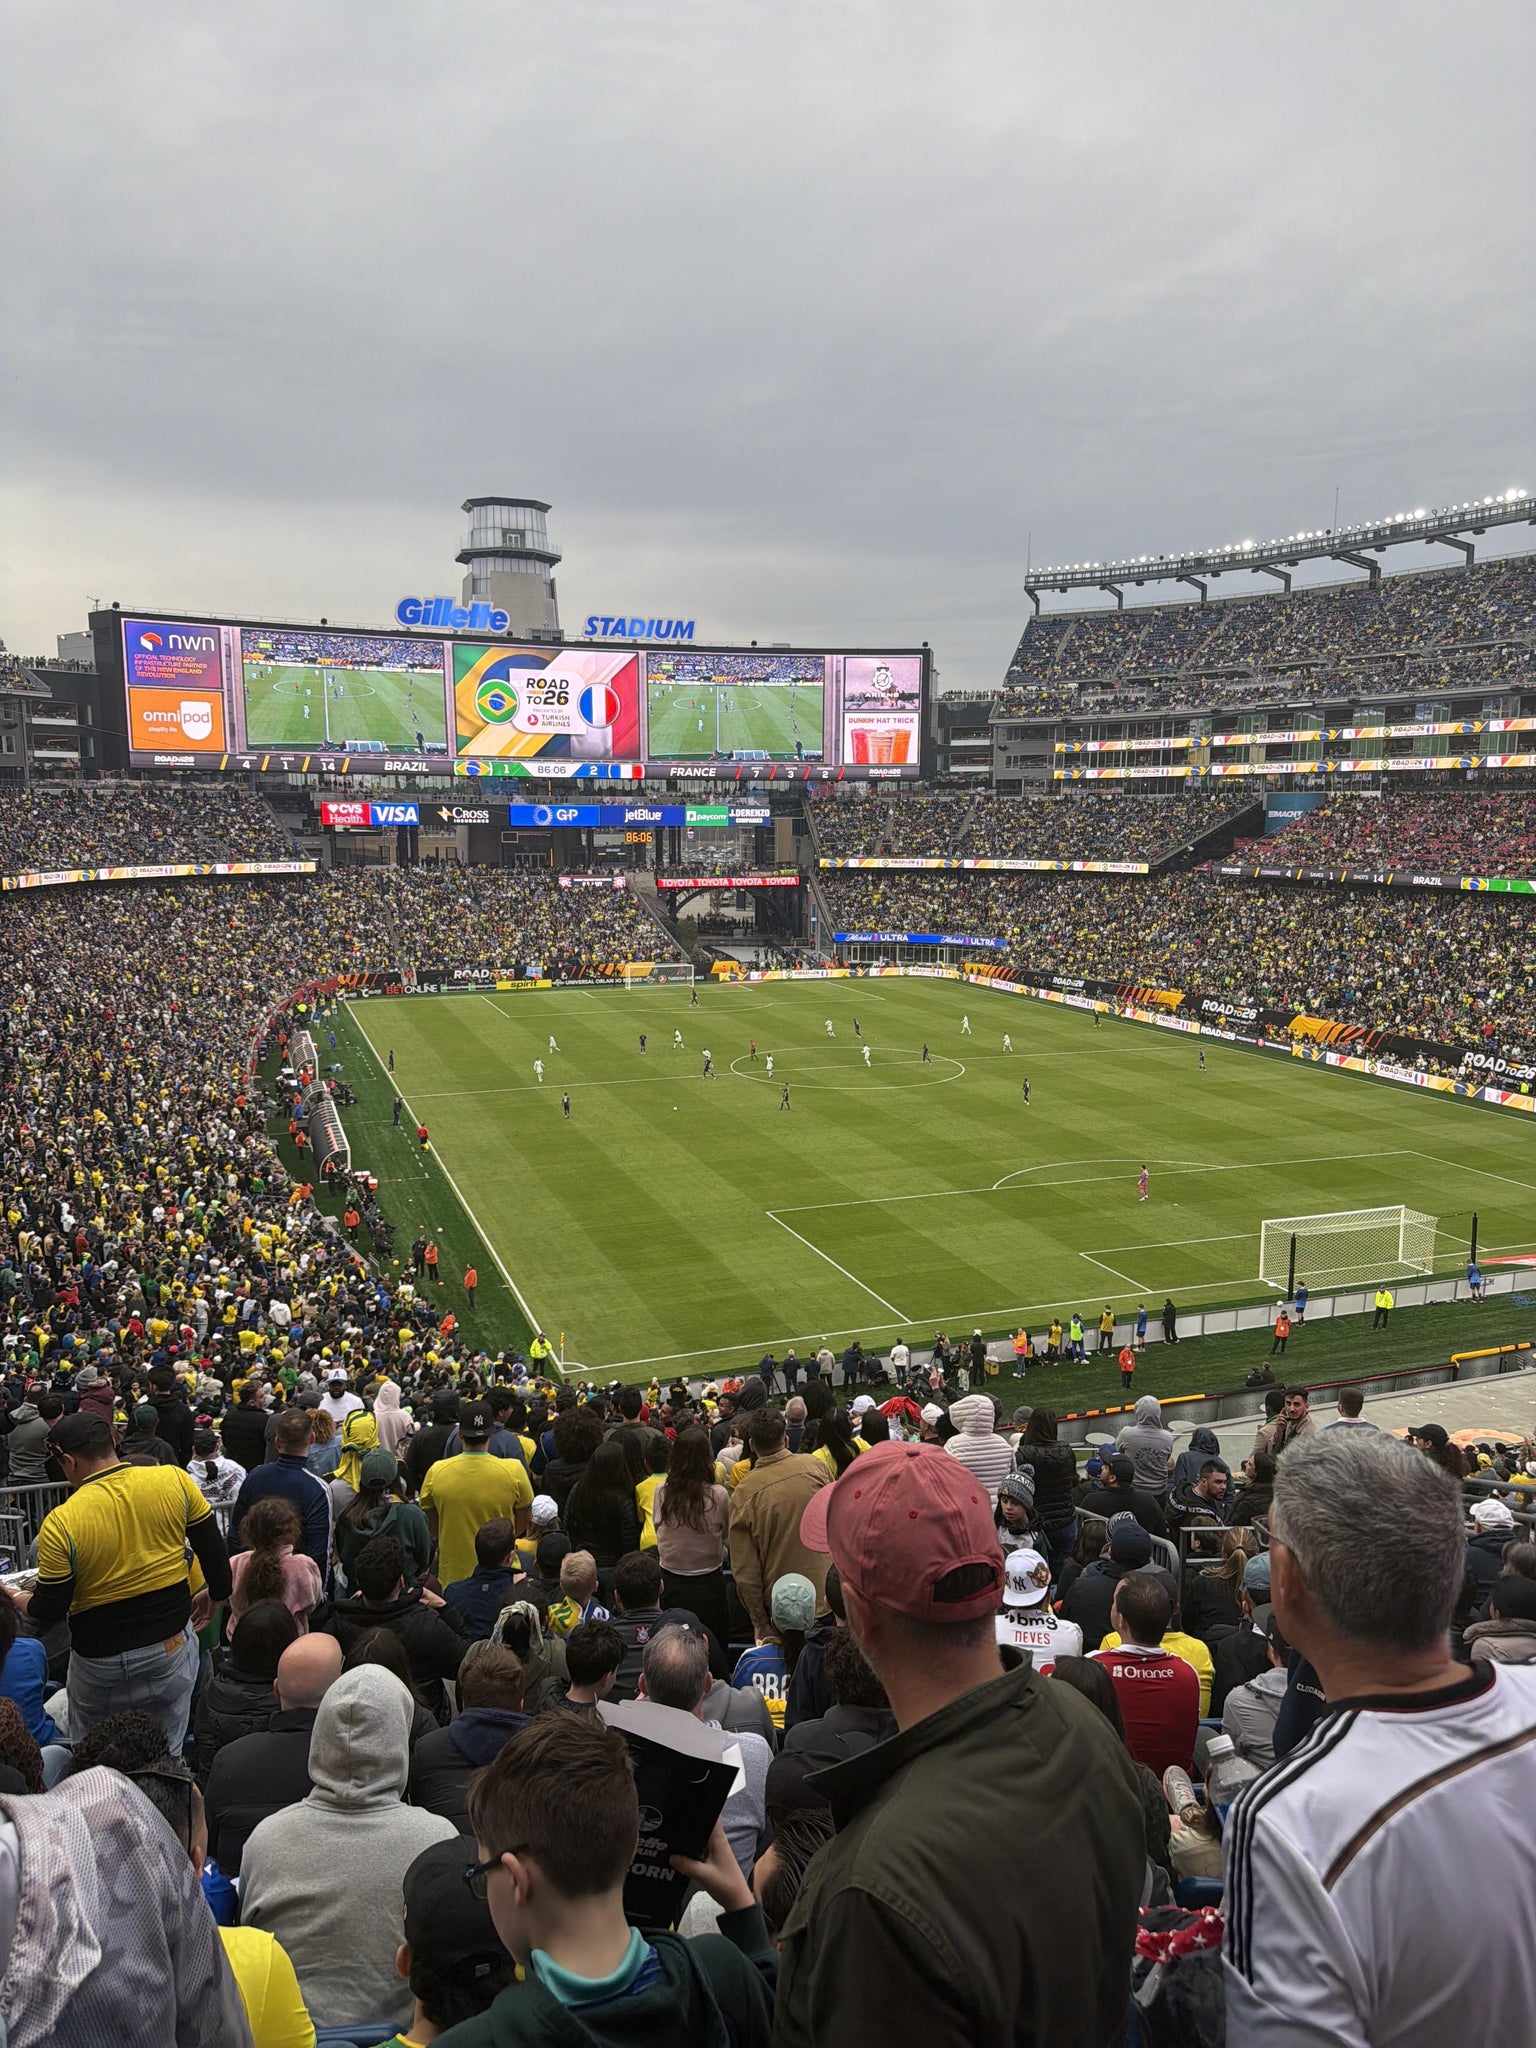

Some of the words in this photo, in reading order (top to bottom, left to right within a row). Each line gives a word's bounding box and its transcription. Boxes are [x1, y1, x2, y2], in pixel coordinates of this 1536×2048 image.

[397, 598, 508, 630] Gillette
[584, 616, 695, 639] STADIUM
[169, 635, 214, 651] nwn
[526, 678, 569, 689] ROAD
[242, 760, 250, 769] 4
[283, 761, 288, 770] 1
[321, 762, 335, 771] 14
[384, 761, 429, 772] BRAZIL
[504, 764, 509, 774] 1
[590, 766, 597, 775] 2
[670, 767, 716, 777] FRANCE
[753, 770, 759, 778] 7
[787, 770, 794, 778] 3
[822, 771, 829, 779] 2
[339, 804, 363, 813] CVS
[371, 806, 417, 822] VISA
[624, 809, 662, 823] jetBlue
[625, 832, 652, 842] 86:06
[1286, 870, 1292, 878] 4
[1329, 872, 1333, 880] 1
[1373, 874, 1384, 883] 14
[662, 879, 694, 887] TOYOTA
[697, 878, 729, 887] TOYOTA
[732, 878, 763, 886] TOYOTA
[766, 877, 796, 885] TOYOTA
[1413, 876, 1443, 885] BRAZIL
[1506, 882, 1512, 890] 1
[880, 933, 908, 941] ULTRA
[970, 938, 996, 946] ULTRA
[453, 968, 489, 979] ROAD
[510, 980, 538, 989] spirit
[1052, 976, 1071, 986] ROAD
[386, 984, 438, 994] BETONLINE
[1202, 1000, 1234, 1015] ROAD
[1241, 1007, 1257, 1019] 26
[1200, 1026, 1222, 1037] ROAD
[1227, 1032, 1236, 1041] 26
[1380, 1065, 1399, 1074] ROAD
[1464, 1052, 1507, 1072] ROAD
[1504, 1066, 1517, 1076] TO
[1515, 1065, 1536, 1080] 26
[1411, 1375, 1439, 1387] Optum
[1308, 1394, 1325, 1404] tum
[1012, 1575, 1027, 1592] NY
[1017, 1613, 1058, 1630] bmg
[630, 1863, 675, 1882] ORN
